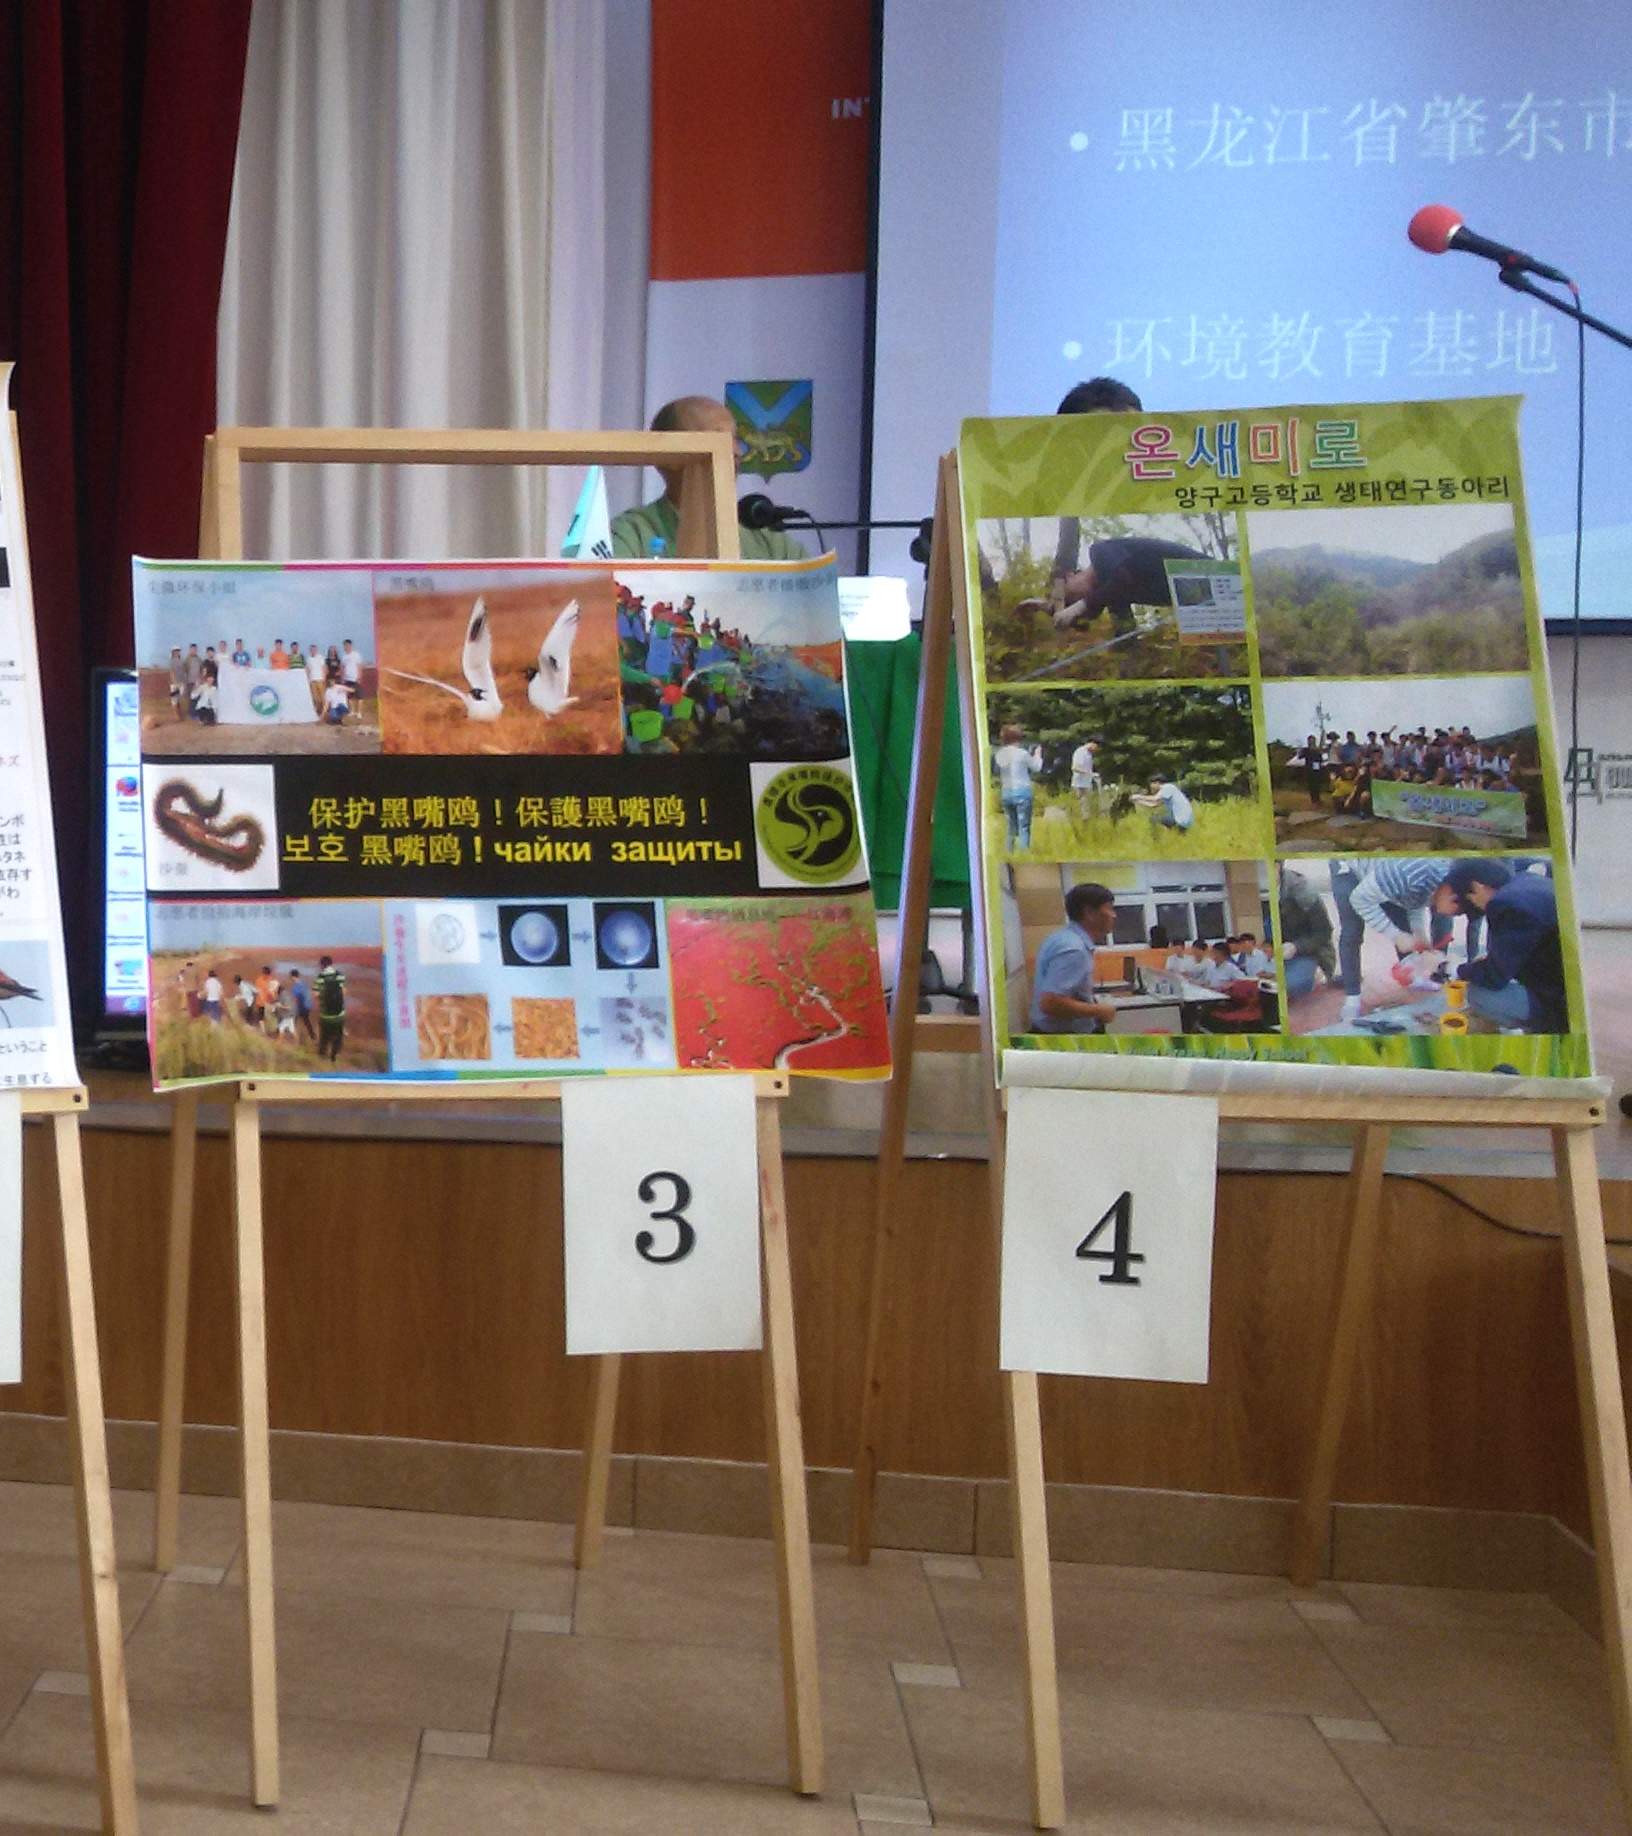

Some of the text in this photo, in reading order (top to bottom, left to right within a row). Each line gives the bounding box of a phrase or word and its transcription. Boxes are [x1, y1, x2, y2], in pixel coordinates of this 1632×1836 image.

[831, 96, 871, 119] IN
[1113, 89, 1632, 172] 黑龙江省肇东市
[1103, 309, 1558, 382] 环境教育基地
[1124, 417, 1367, 480] 온새미로
[1175, 476, 1509, 508] 양구고등학교 생태연구동아리
[282, 834, 349, 863] 보호
[494, 834, 592, 863] чайки
[611, 838, 742, 866] защиты
[634, 1171, 699, 1264] 3
[1074, 1190, 1147, 1287] 4
